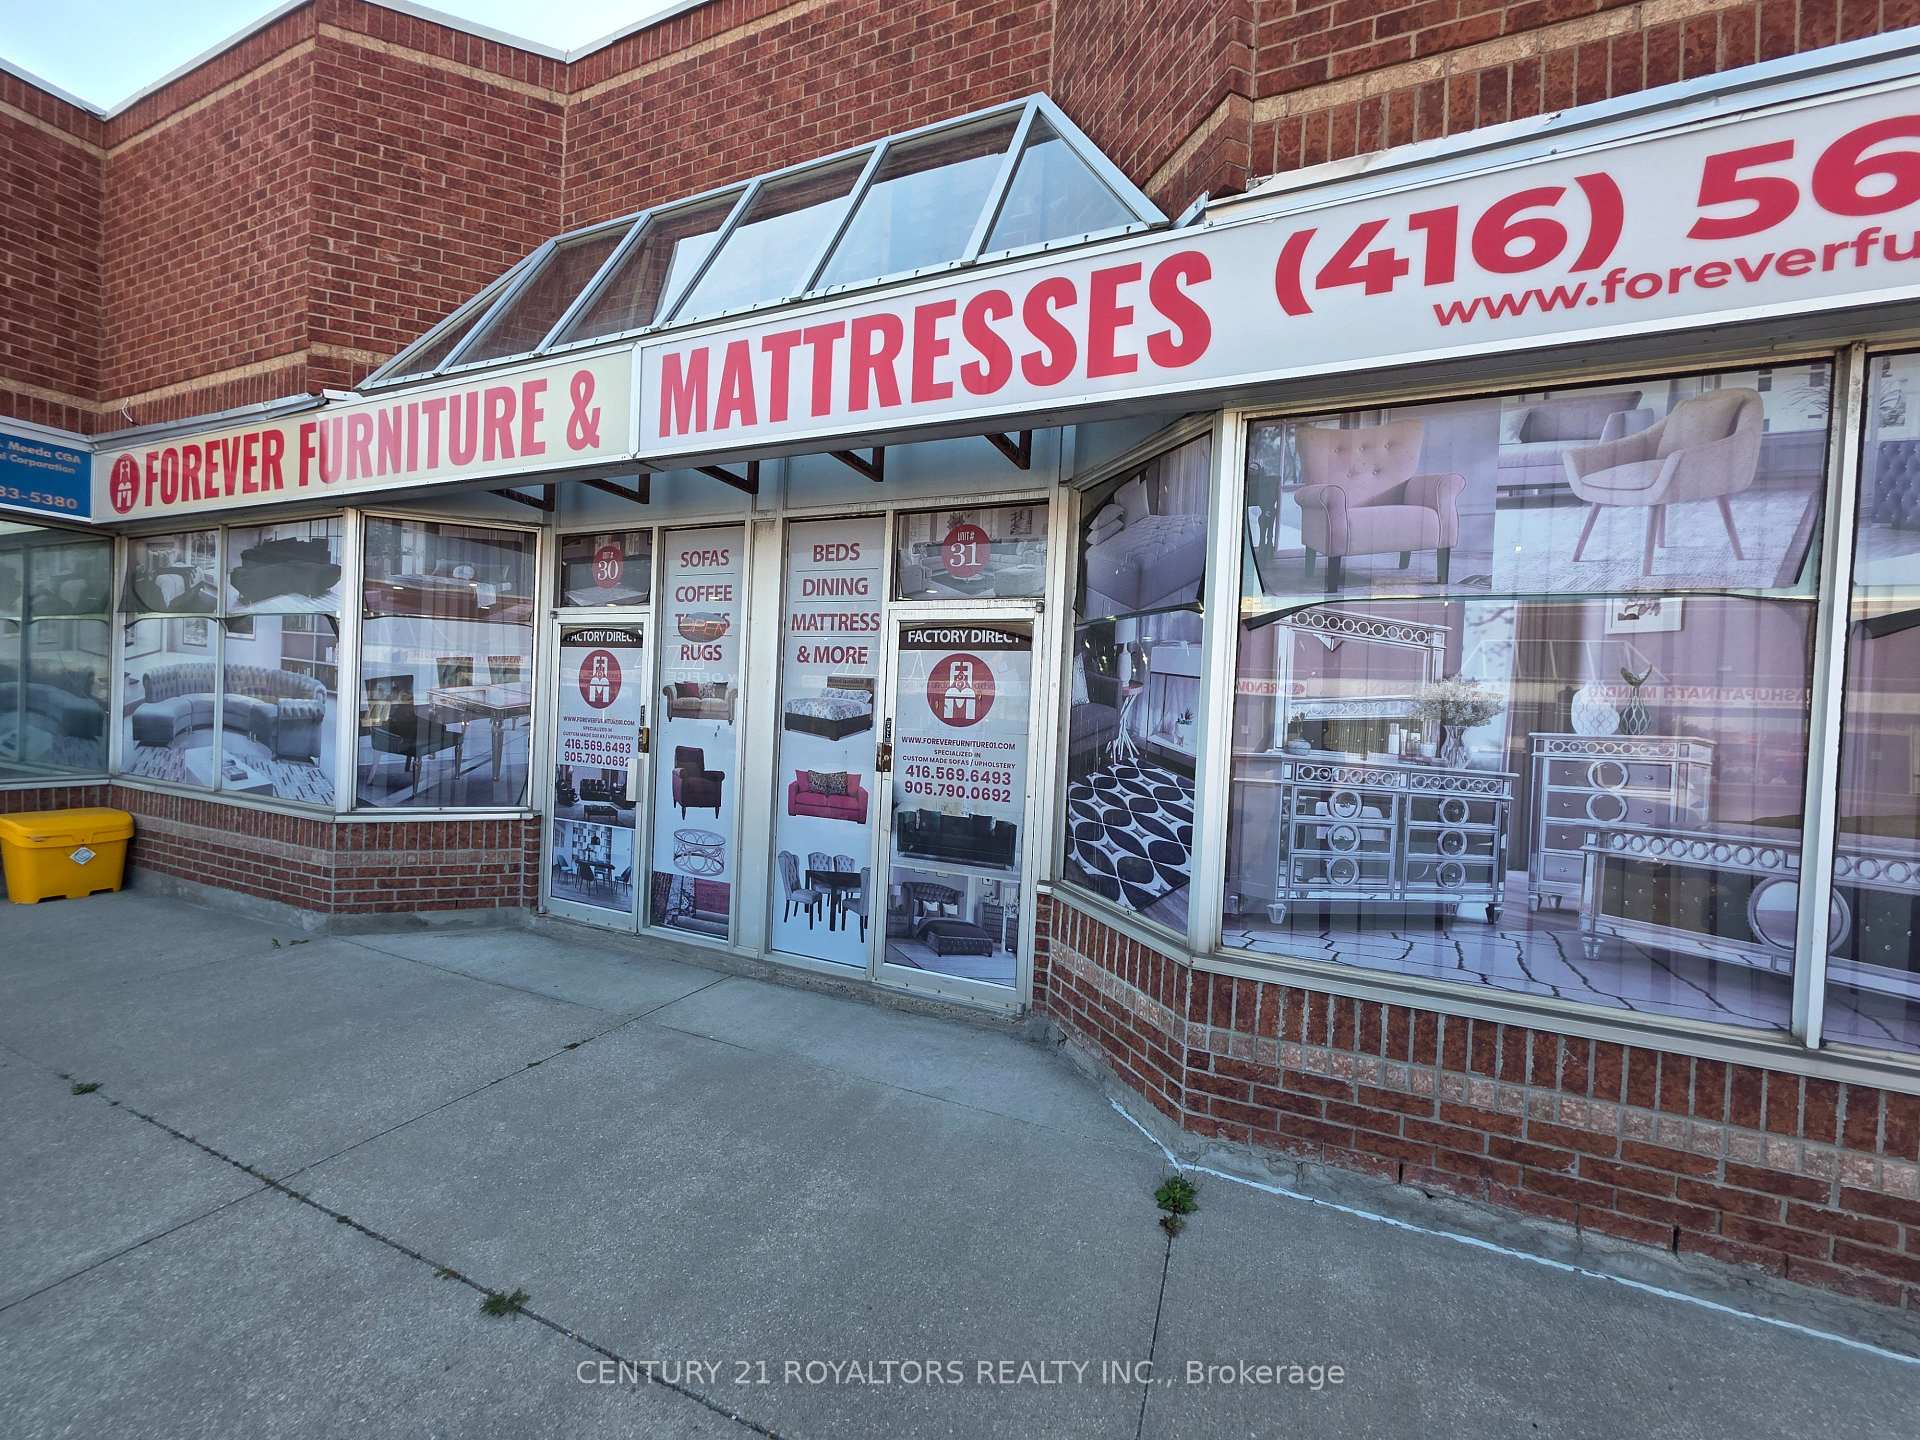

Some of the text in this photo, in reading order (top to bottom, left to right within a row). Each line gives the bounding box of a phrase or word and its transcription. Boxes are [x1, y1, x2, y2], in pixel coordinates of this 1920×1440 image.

[1274, 114, 1920, 316] (416) 56
[1433, 226, 1920, 327] www.foreverfu
[144, 250, 1212, 507] FOREVER FURNITURE & MATTRESSES
[9, 454, 76, 475] Corporation
[55, 451, 82, 465] CGA
[680, 549, 730, 568] SOFAS
[813, 543, 860, 562] BEDS
[950, 542, 983, 567] 31
[597, 560, 619, 580] 30
[675, 585, 733, 603] COFFEE
[802, 578, 868, 596] DINING
[792, 613, 880, 632] MATTRESS
[566, 631, 606, 642] ACTORY
[908, 629, 968, 643] FACTORY
[680, 644, 722, 661] RUGS
[797, 646, 868, 665] & MORE
[564, 738, 632, 754] 416.569.6493
[934, 749, 973, 758] SPECIALIZED
[902, 755, 929, 763] CUSTOM
[948, 758, 969, 766] SOFAS
[974, 760, 1016, 769] UPHOLSTERY
[905, 764, 1012, 786] 416.569.6493
[904, 780, 1012, 803] 905.790.0692
